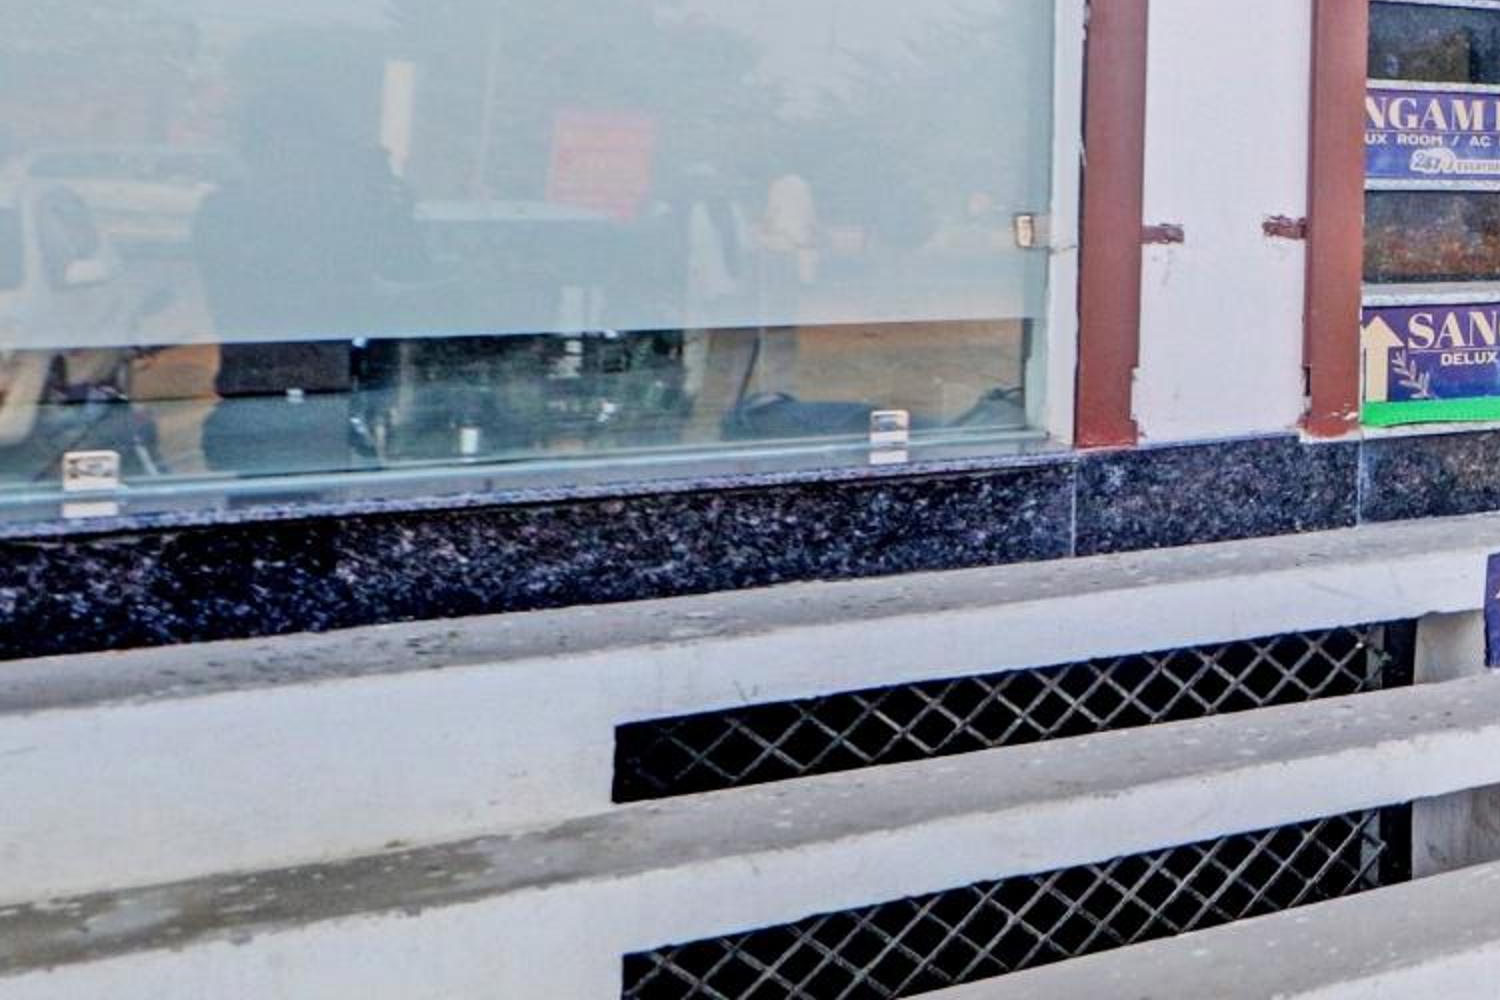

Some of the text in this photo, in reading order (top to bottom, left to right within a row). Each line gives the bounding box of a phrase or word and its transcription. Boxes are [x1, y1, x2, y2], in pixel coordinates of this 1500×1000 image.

[1365, 96, 1484, 131] NGAM
[1397, 134, 1443, 146] ROOM
[1470, 135, 1490, 148] AC
[1441, 350, 1498, 365] DELUX
